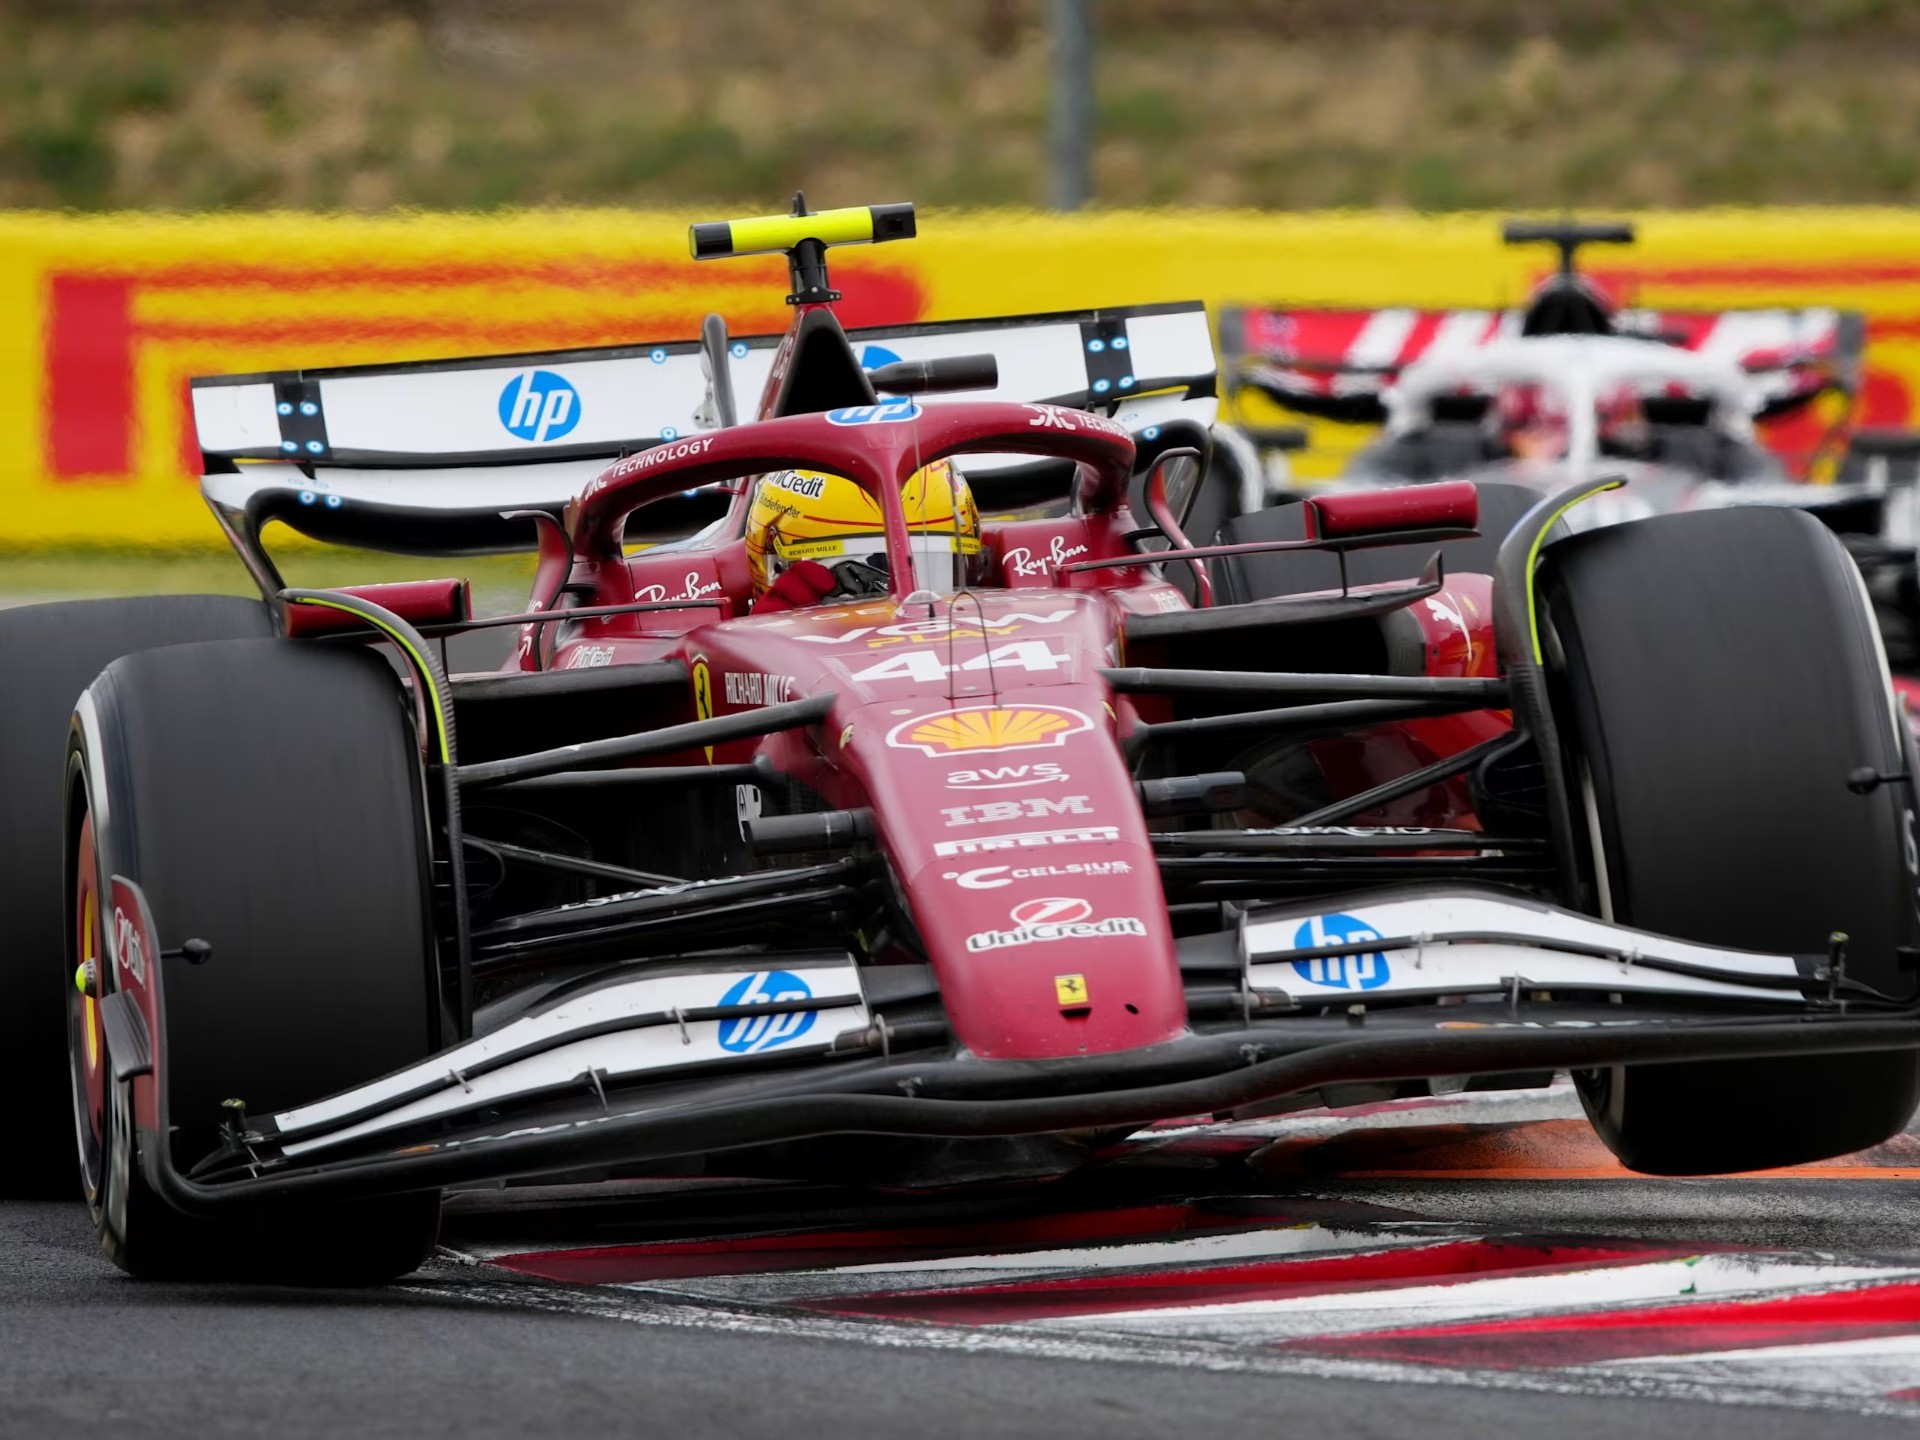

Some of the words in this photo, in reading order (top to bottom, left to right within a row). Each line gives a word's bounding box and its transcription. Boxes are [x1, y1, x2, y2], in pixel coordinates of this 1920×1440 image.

[503, 371, 578, 441] hp
[1021, 404, 1077, 431] DXC
[612, 437, 714, 478] TECHNOLOGY
[1002, 535, 1089, 577] Ray-Ban
[792, 609, 1078, 644] VGW
[866, 625, 1023, 648] PLAY
[851, 640, 1072, 682] 44
[724, 672, 762, 704] RICHARD
[763, 674, 796, 706] MILLE
[946, 763, 1066, 787] aws
[940, 796, 1094, 827] IBM
[933, 826, 1120, 857] PIRELLI
[1012, 860, 1130, 879] CELSIUS
[969, 917, 1145, 950] UniCredit
